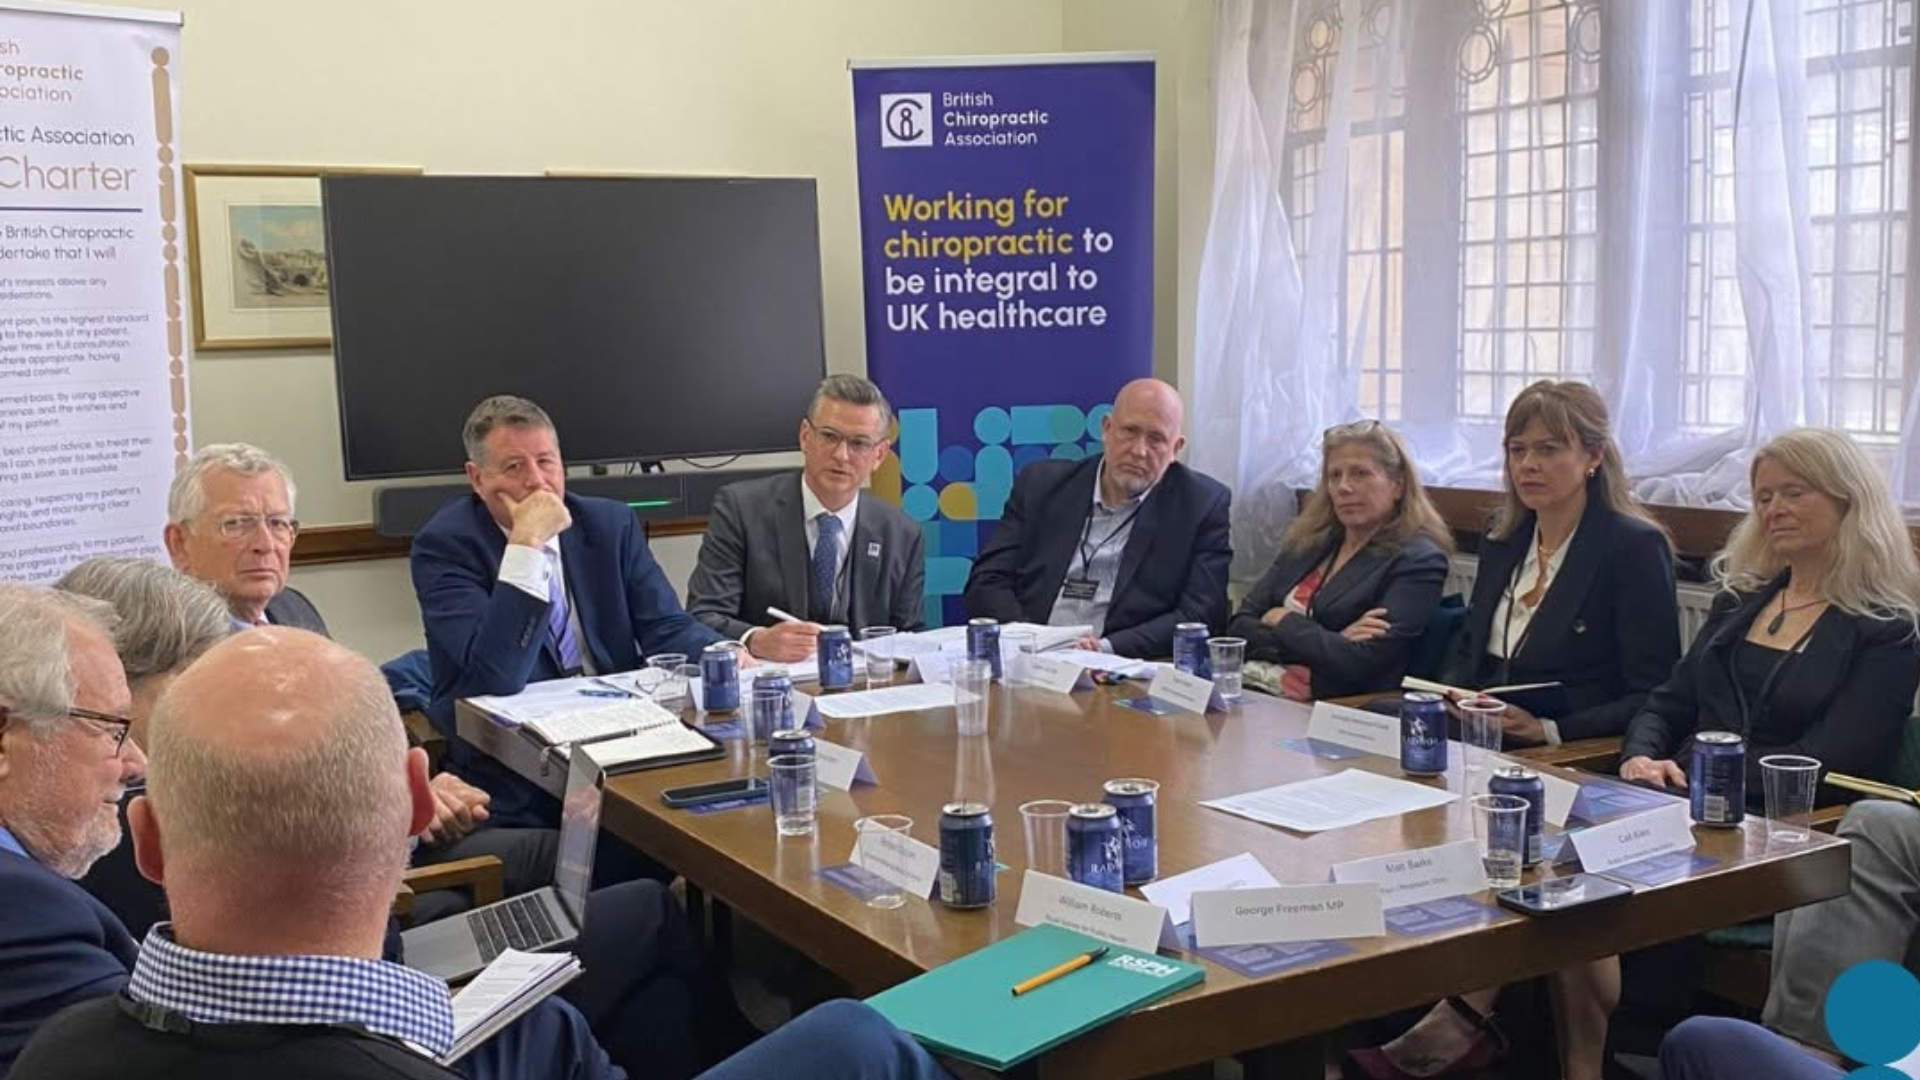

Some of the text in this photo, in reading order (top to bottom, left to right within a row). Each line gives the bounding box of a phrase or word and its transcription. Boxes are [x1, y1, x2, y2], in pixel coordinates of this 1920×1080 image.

[943, 92, 993, 107] British
[943, 110, 1049, 129] Chiropractic
[31, 126, 135, 146] Association
[944, 131, 1037, 147] Association
[0, 155, 137, 191] Charter
[884, 189, 1069, 226] Working for
[6, 225, 135, 241] British Chiropractic
[55, 247, 82, 260] that
[95, 247, 117, 260] will
[884, 228, 1113, 264] chiropractic to
[57, 278, 86, 287] above
[89, 278, 107, 289] any
[886, 262, 1097, 299] be integral to
[54, 315, 68, 325] the
[70, 313, 105, 327] highest
[107, 312, 149, 323] standard
[887, 300, 1107, 332] UK healthcare
[18, 330, 33, 339] the
[35, 328, 64, 338] needs
[57, 340, 70, 349] full
[88, 353, 120, 364] having
[58, 391, 69, 402] by
[71, 391, 97, 401] using
[98, 388, 140, 399] objective
[37, 404, 56, 413] and
[59, 404, 74, 413] the
[75, 403, 107, 413] wishes
[109, 401, 128, 410] and
[8, 423, 22, 433] my
[3, 447, 25, 456] best
[27, 443, 58, 454] clinical
[107, 438, 130, 448] treat
[49, 456, 72, 466] order
[87, 451, 119, 461] reduce
[21, 471, 32, 480] as
[35, 470, 56, 479] soon
[36, 491, 83, 504] respecting
[85, 491, 99, 502] my
[31, 508, 50, 518] and
[52, 502, 106, 516] maintaining
[107, 499, 130, 509] clear
[16, 556, 57, 571] progress
[1235, 901, 1344, 917] George Freeman MP
